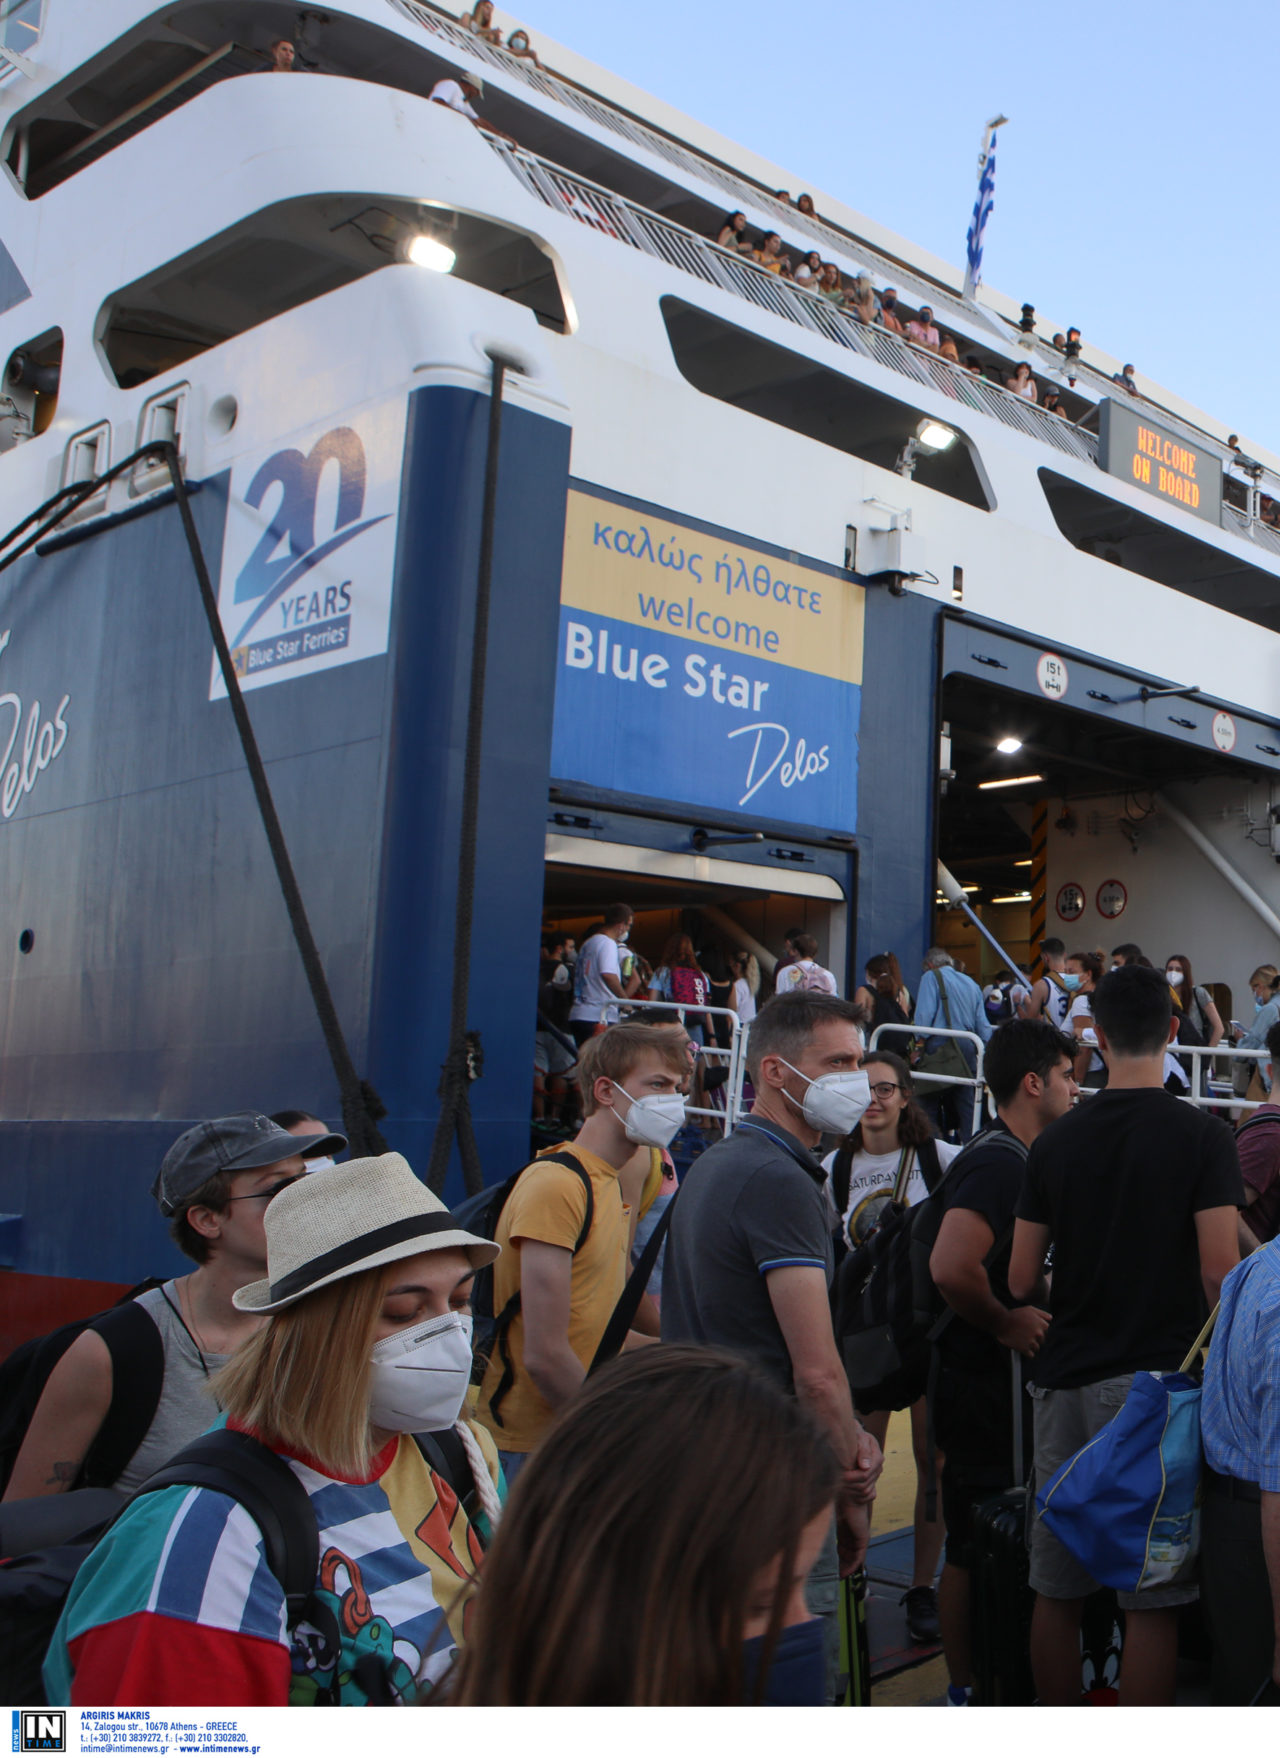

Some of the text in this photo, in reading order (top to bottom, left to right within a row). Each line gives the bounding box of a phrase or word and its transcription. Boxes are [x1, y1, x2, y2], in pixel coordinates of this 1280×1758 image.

[1132, 453, 1199, 508] ON BOARD
[1138, 426, 1196, 478] WELCOME
[234, 427, 366, 605] 20
[593, 521, 822, 615] καλώς ήλθατε
[281, 580, 352, 629] YEARS
[638, 592, 780, 654] welcome
[249, 626, 346, 667] Blue Star Ferries
[565, 622, 769, 711] Blue Star
[1047, 661, 1061, 676] 15t
[728, 722, 829, 806] Delos
